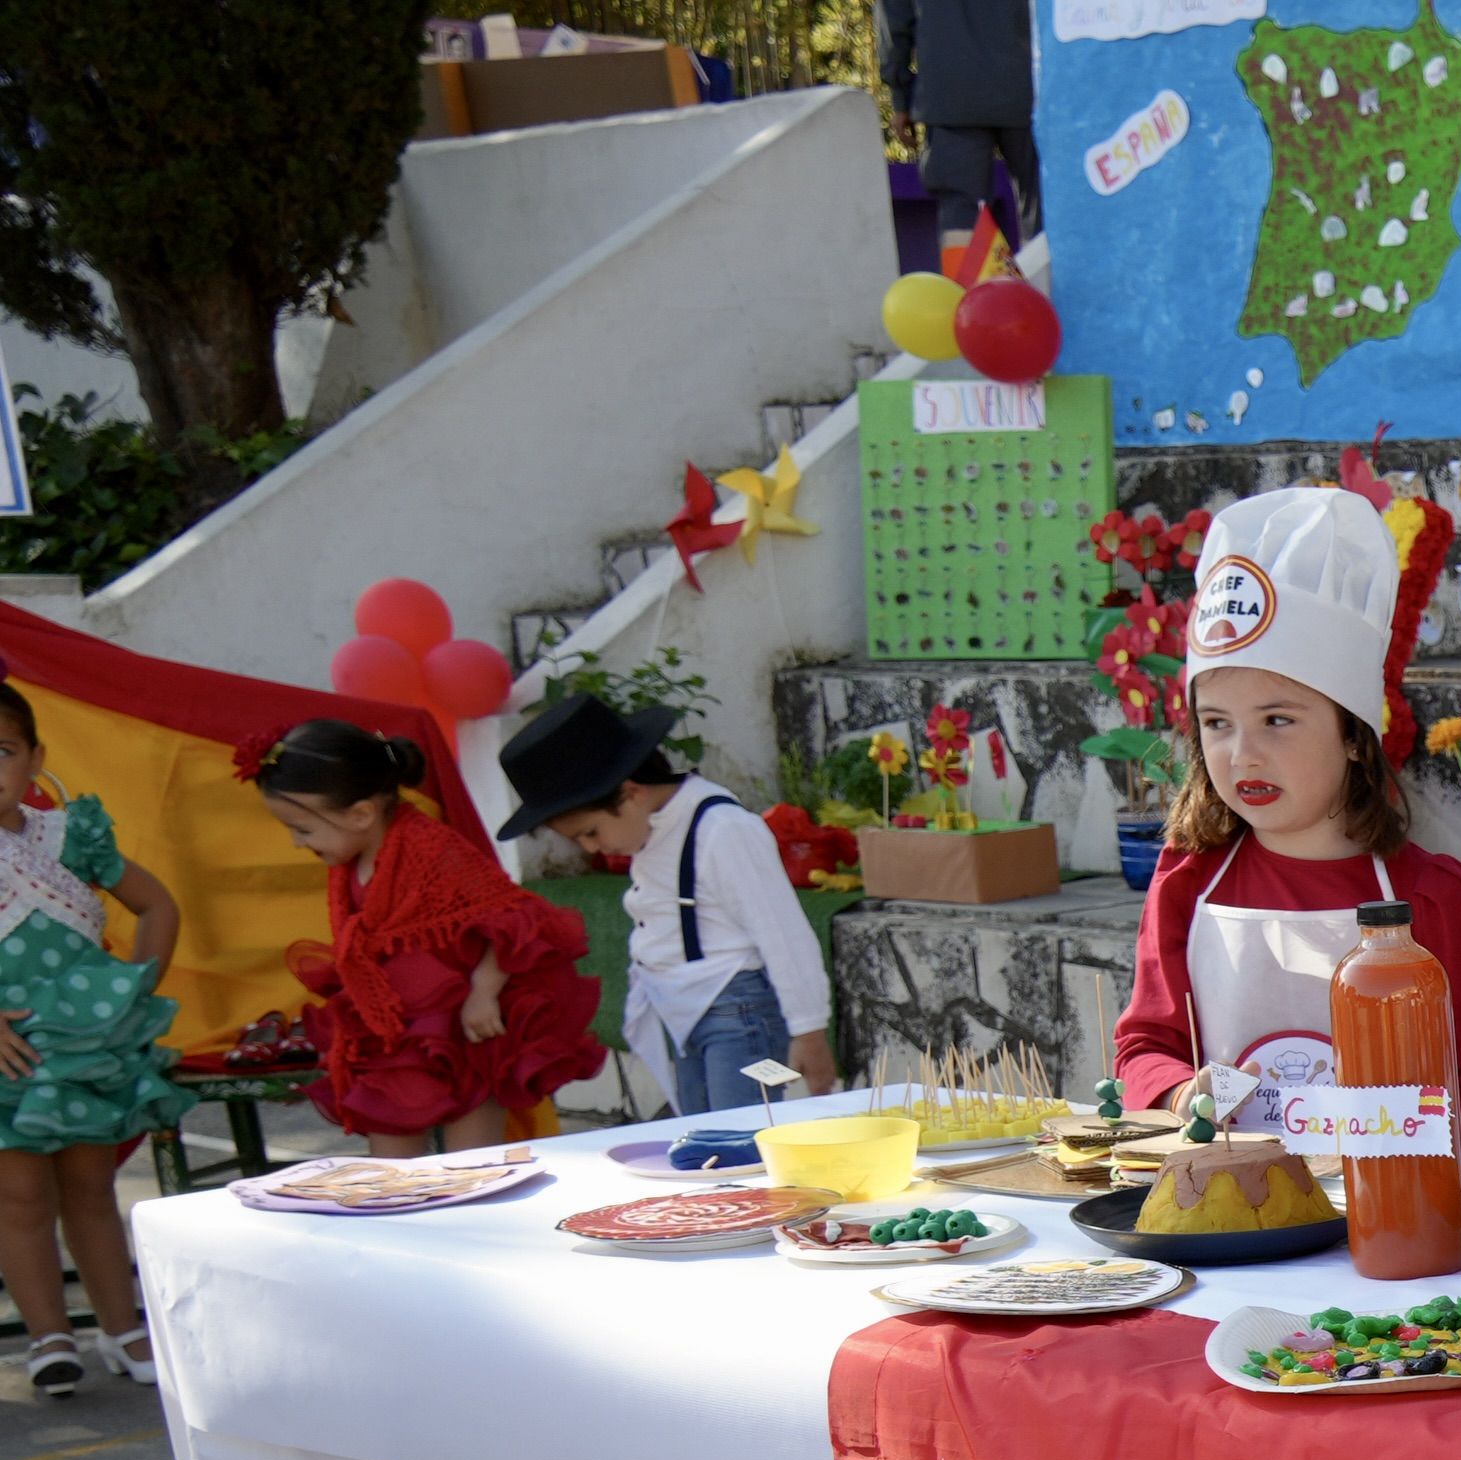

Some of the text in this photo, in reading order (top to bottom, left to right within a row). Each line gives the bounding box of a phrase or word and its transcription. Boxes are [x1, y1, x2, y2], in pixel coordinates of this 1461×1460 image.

[1096, 100, 1185, 188] ESPAÑA
[1211, 576, 1244, 595] CHEF
[1199, 600, 1259, 623] DANIELA
[1284, 1097, 1426, 1155] Gazpacho
